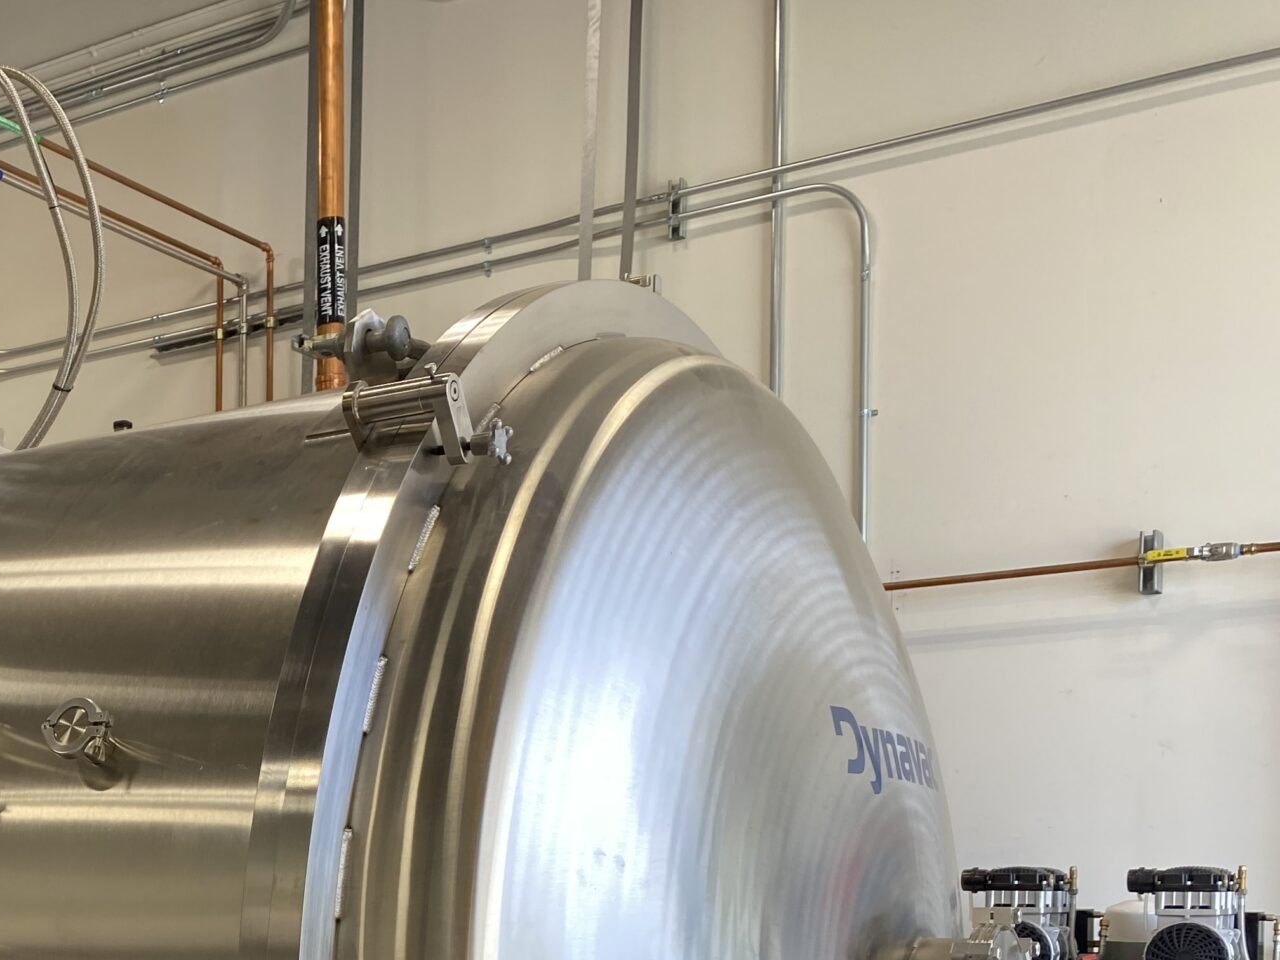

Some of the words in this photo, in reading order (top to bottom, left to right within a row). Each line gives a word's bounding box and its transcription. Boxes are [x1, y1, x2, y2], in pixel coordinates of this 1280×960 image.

[320, 245, 332, 288] EXHAUST
[335, 243, 345, 269] VENT
[321, 290, 333, 316] VENT
[335, 271, 345, 316] EXHAUST
